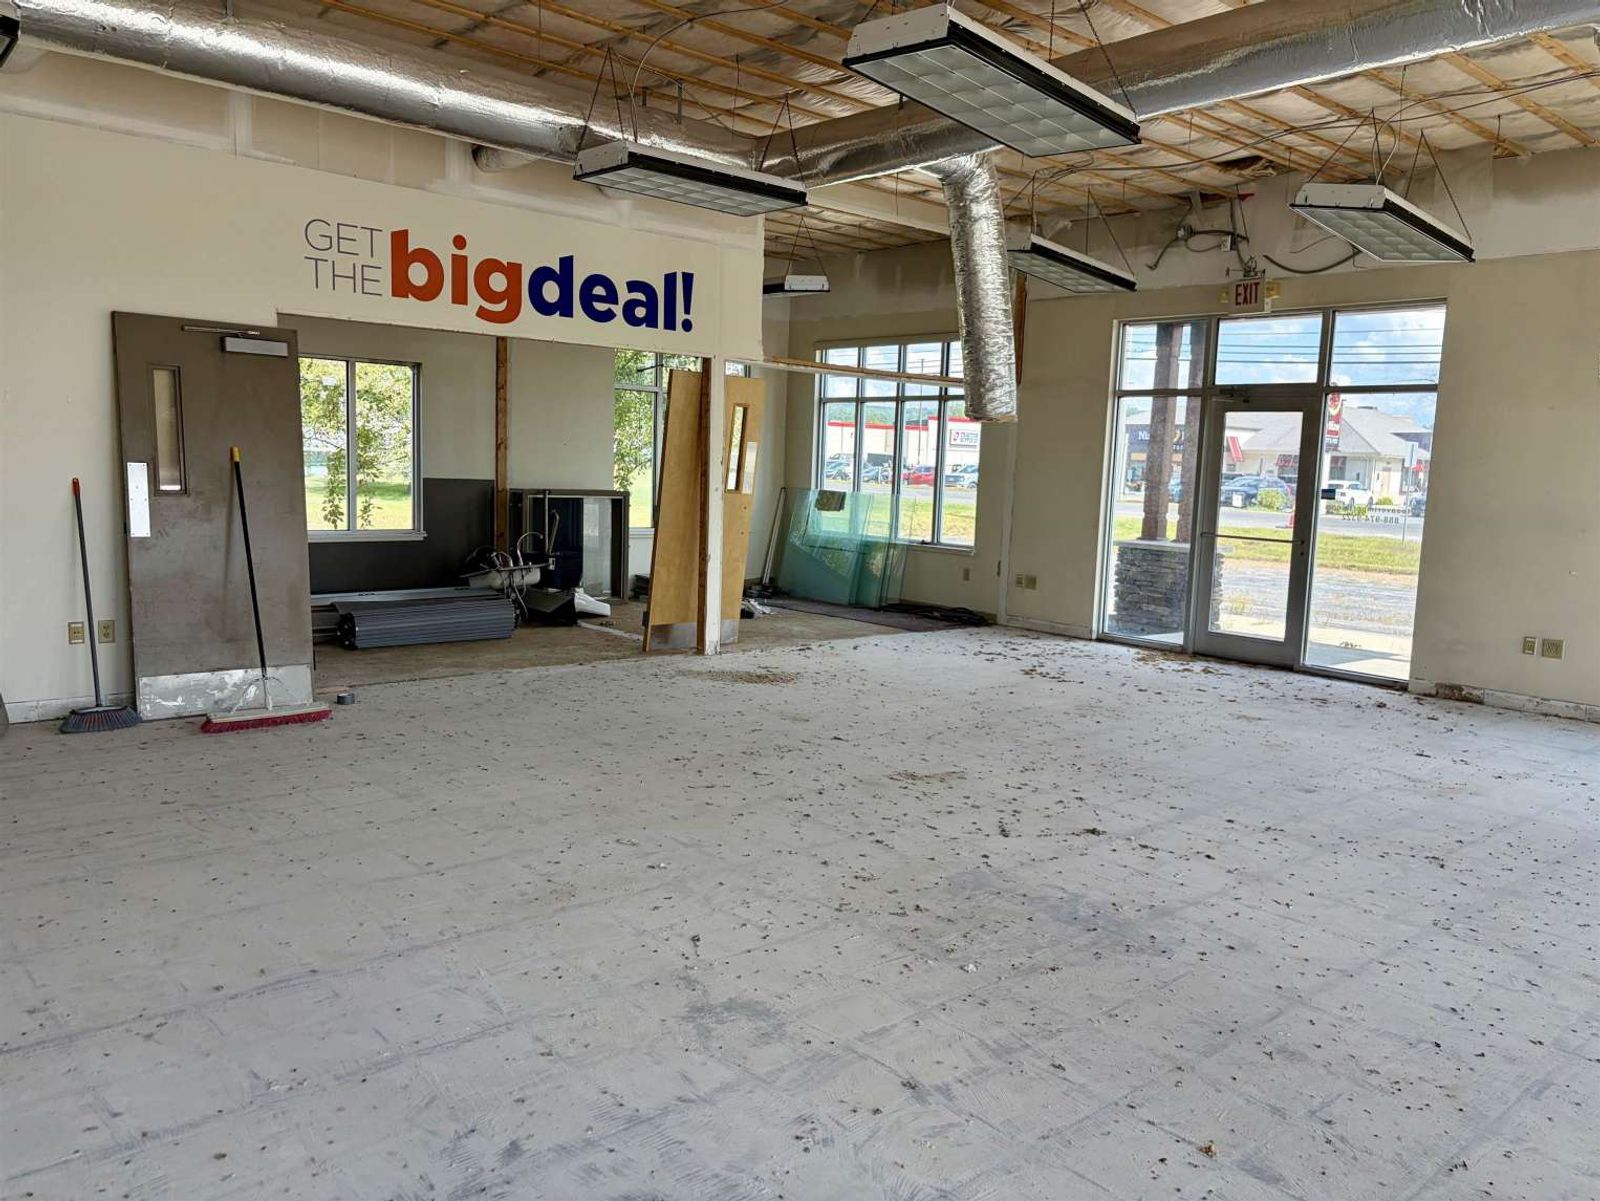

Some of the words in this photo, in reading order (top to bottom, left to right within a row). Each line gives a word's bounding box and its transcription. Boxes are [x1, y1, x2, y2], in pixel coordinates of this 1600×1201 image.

[304, 218, 383, 257] GET
[304, 256, 383, 296] THE
[1235, 281, 1260, 306] EXIT
